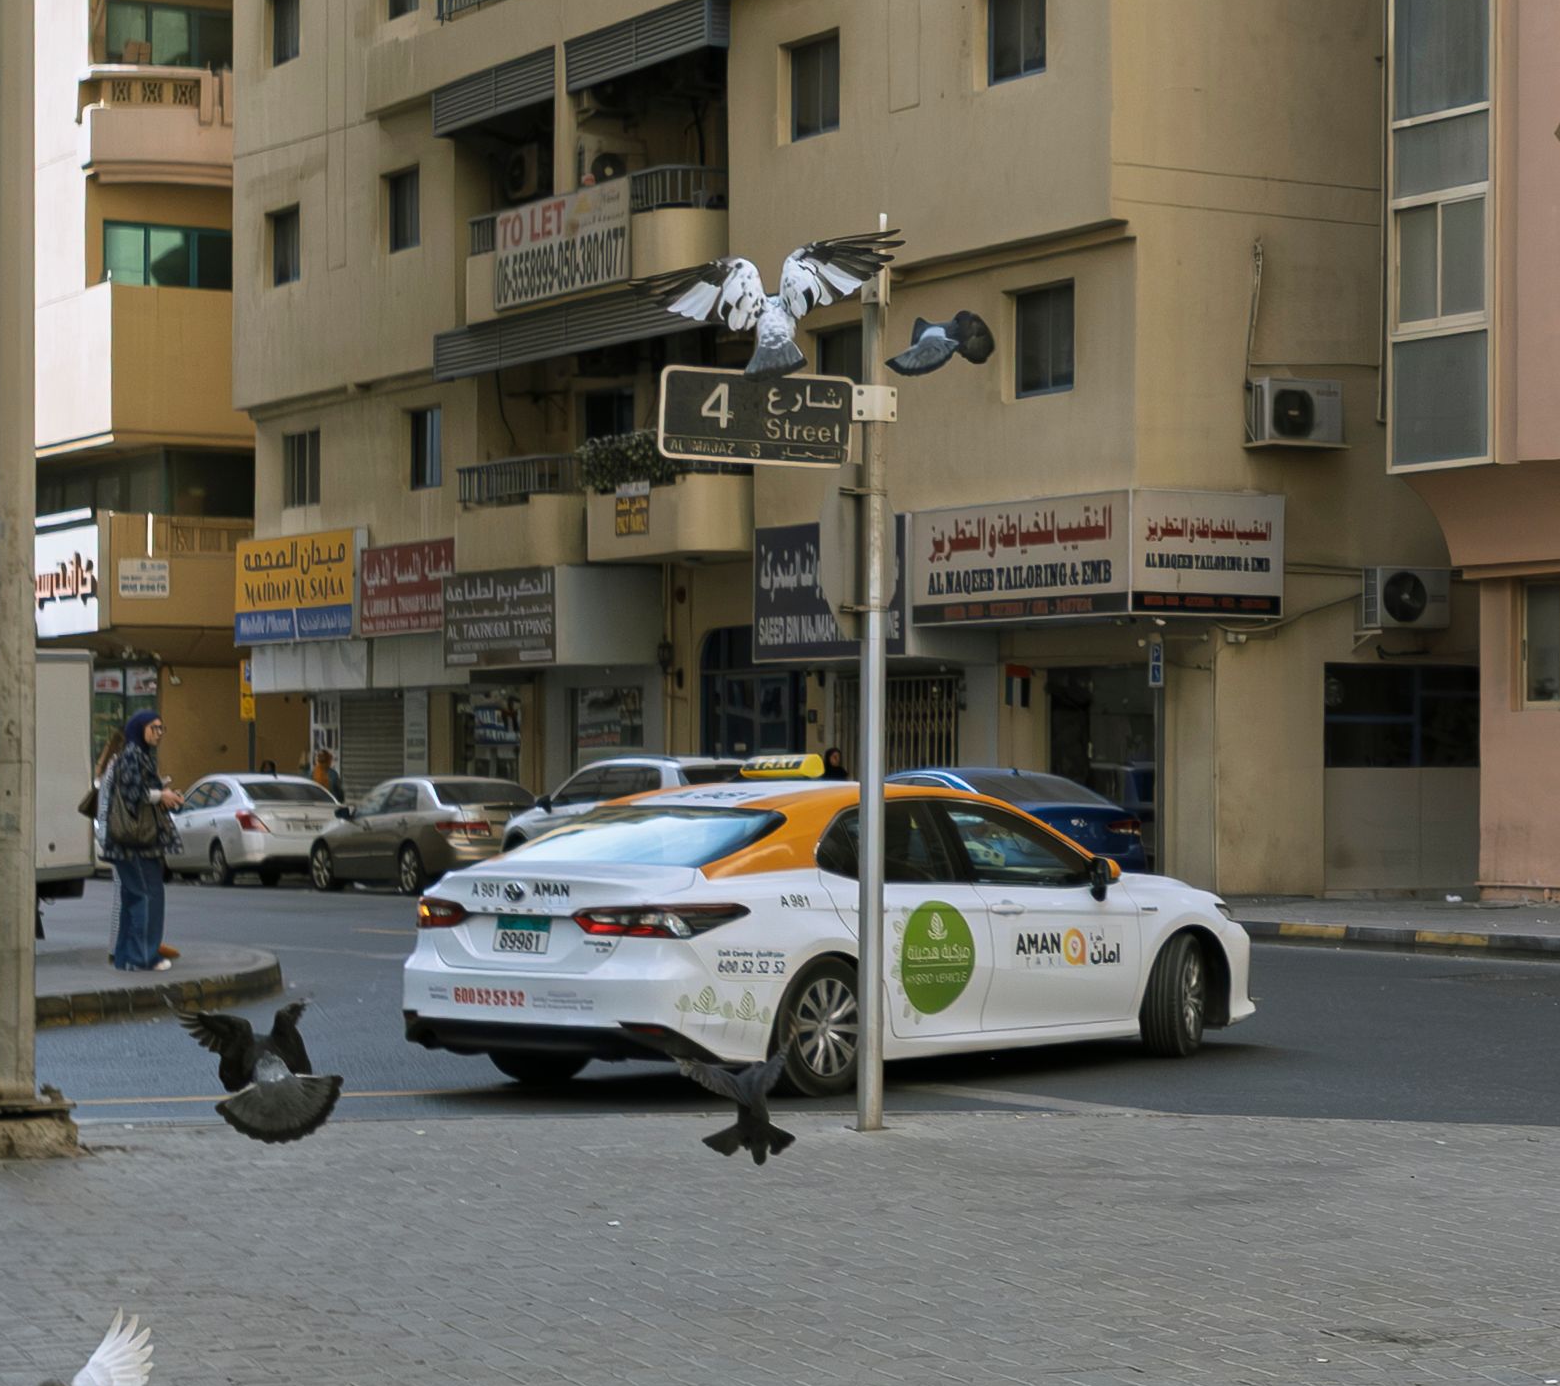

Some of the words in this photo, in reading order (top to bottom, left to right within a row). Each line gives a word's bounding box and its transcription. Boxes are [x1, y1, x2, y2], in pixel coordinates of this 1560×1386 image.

[500, 214, 523, 250] TO
[529, 199, 566, 242] LET
[701, 382, 734, 429] 4
[767, 385, 843, 415] شارع
[766, 418, 841, 444] Street
[670, 440, 684, 453] AL
[690, 441, 736, 455] MAJAZ
[750, 443, 761, 458] 3
[998, 510, 1055, 555] للخياطة
[1056, 504, 1112, 550] النقيب
[1195, 517, 1235, 544] للخياطة
[1235, 520, 1272, 546] النقيب
[301, 539, 346, 575] ميدان
[1145, 553, 1157, 568] AL
[1158, 553, 1193, 570] NAQEEB
[1195, 554, 1242, 572] TAILORING
[1243, 557, 1250, 572] &
[1251, 557, 1271, 573] EMB
[928, 572, 944, 596] AL
[945, 568, 995, 595] NAQEEB
[996, 562, 1068, 591] TAILORING
[1069, 562, 1080, 585] &
[1081, 559, 1112, 584] EMB
[244, 579, 291, 607] MAIDAN
[294, 577, 306, 604] AL
[447, 624, 459, 640] AL
[514, 617, 552, 636] TYPING
[758, 616, 785, 646] SAEED
[786, 615, 799, 644] BIN
[754, 757, 797, 770] TAXI
[471, 883, 480, 898] A
[481, 882, 501, 898] 981
[532, 883, 570, 897] AMAN
[780, 895, 792, 908] A
[793, 894, 811, 909] 981
[907, 944, 940, 962] هجينة
[941, 943, 971, 961] مركبة
[1016, 932, 1062, 956] AMAN
[718, 960, 739, 973] 600
[740, 960, 754, 974] 52
[756, 960, 770, 974] 52
[772, 960, 787, 974] 52
[936, 971, 968, 984] VEHICLE
